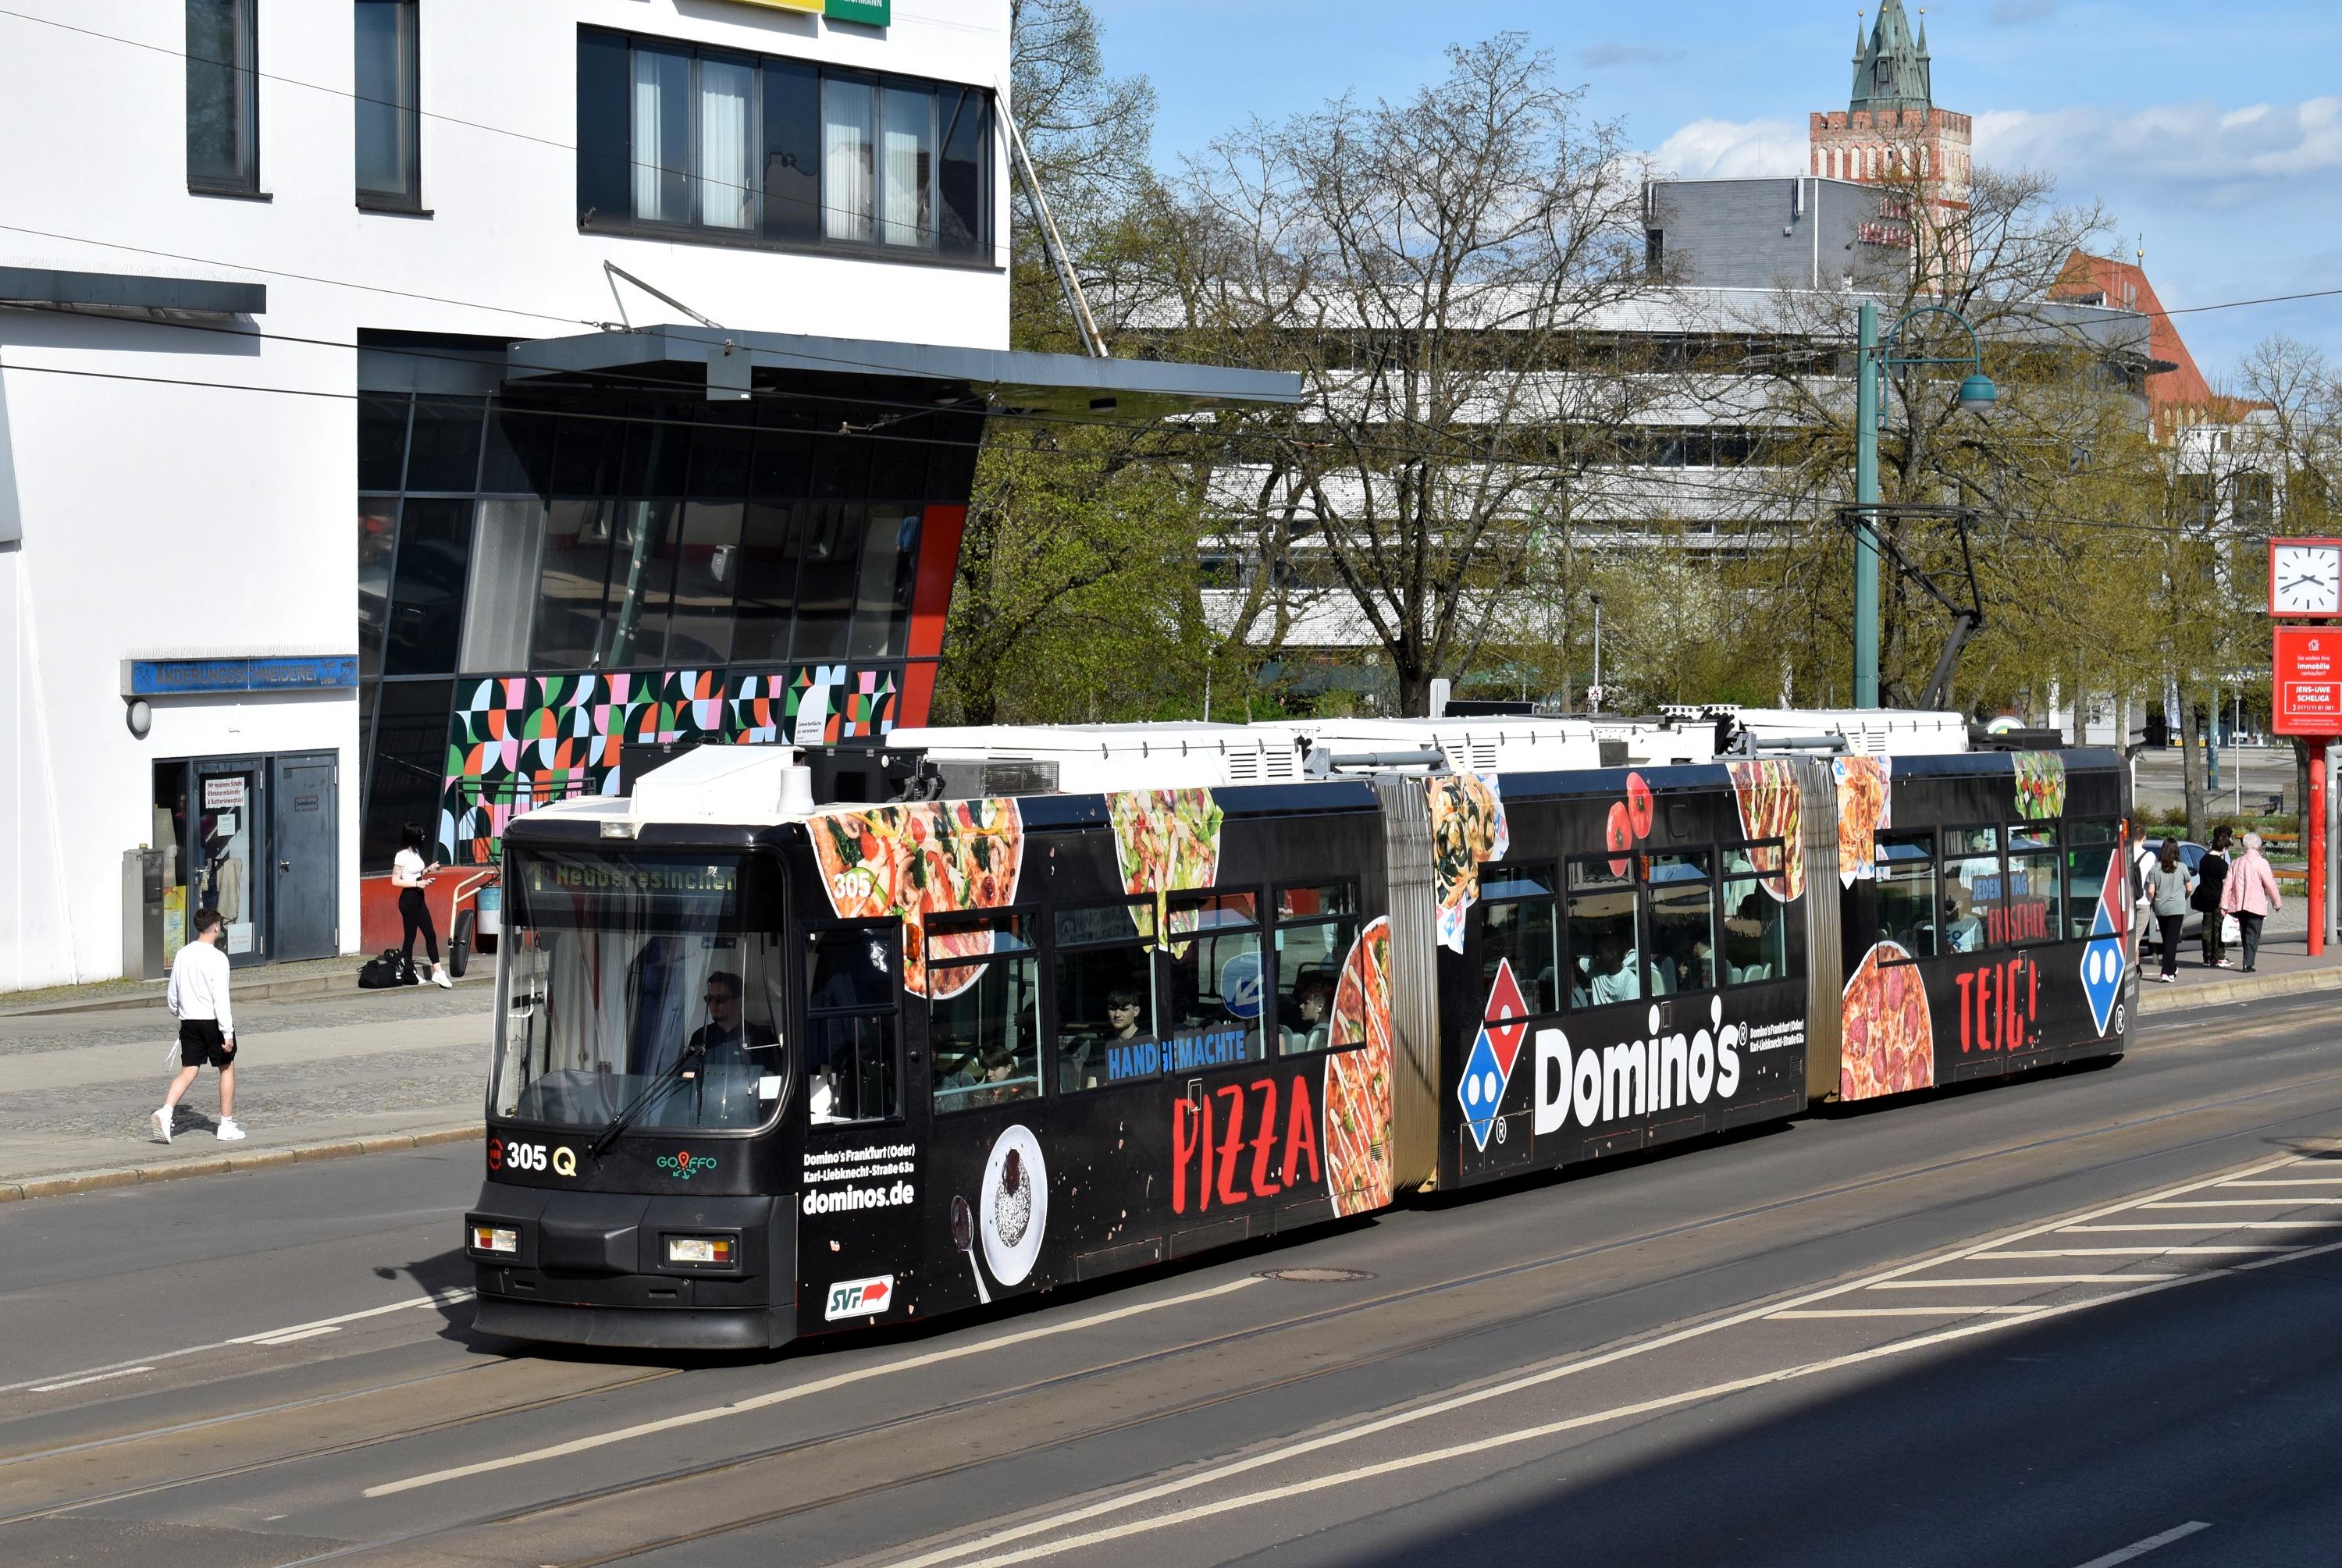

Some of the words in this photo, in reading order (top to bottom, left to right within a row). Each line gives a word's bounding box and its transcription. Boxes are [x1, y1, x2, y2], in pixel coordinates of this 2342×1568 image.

[156, 663, 317, 685] ÄNDERUNGSSCHNEIDEREI
[557, 862, 737, 891] Neuberesinchen
[834, 873, 870, 899] 305
[1973, 878, 2002, 901] JEDEN
[2010, 873, 2028, 895] TAG
[1988, 902, 2048, 944] FRISCHER
[1750, 1025, 1770, 1039] Domino's
[1770, 1022, 1790, 1035] Frankfurt
[1790, 1019, 1804, 1032] (Oder)
[1108, 1030, 1245, 1080] HANDGEMACHTE
[804, 1151, 845, 1166] Domino's
[845, 1146, 887, 1161] Frankfurt
[888, 1143, 915, 1159] (Oder)
[1173, 1075, 1319, 1214] PIZZA
[507, 1142, 546, 1171] 305
[553, 1146, 577, 1177] Q
[803, 1163, 897, 1183] Karl-Liebknecht-Straße
[899, 1161, 914, 1173] 63a
[803, 1180, 914, 1215] dominos.de
[831, 1286, 862, 1312] SVF
